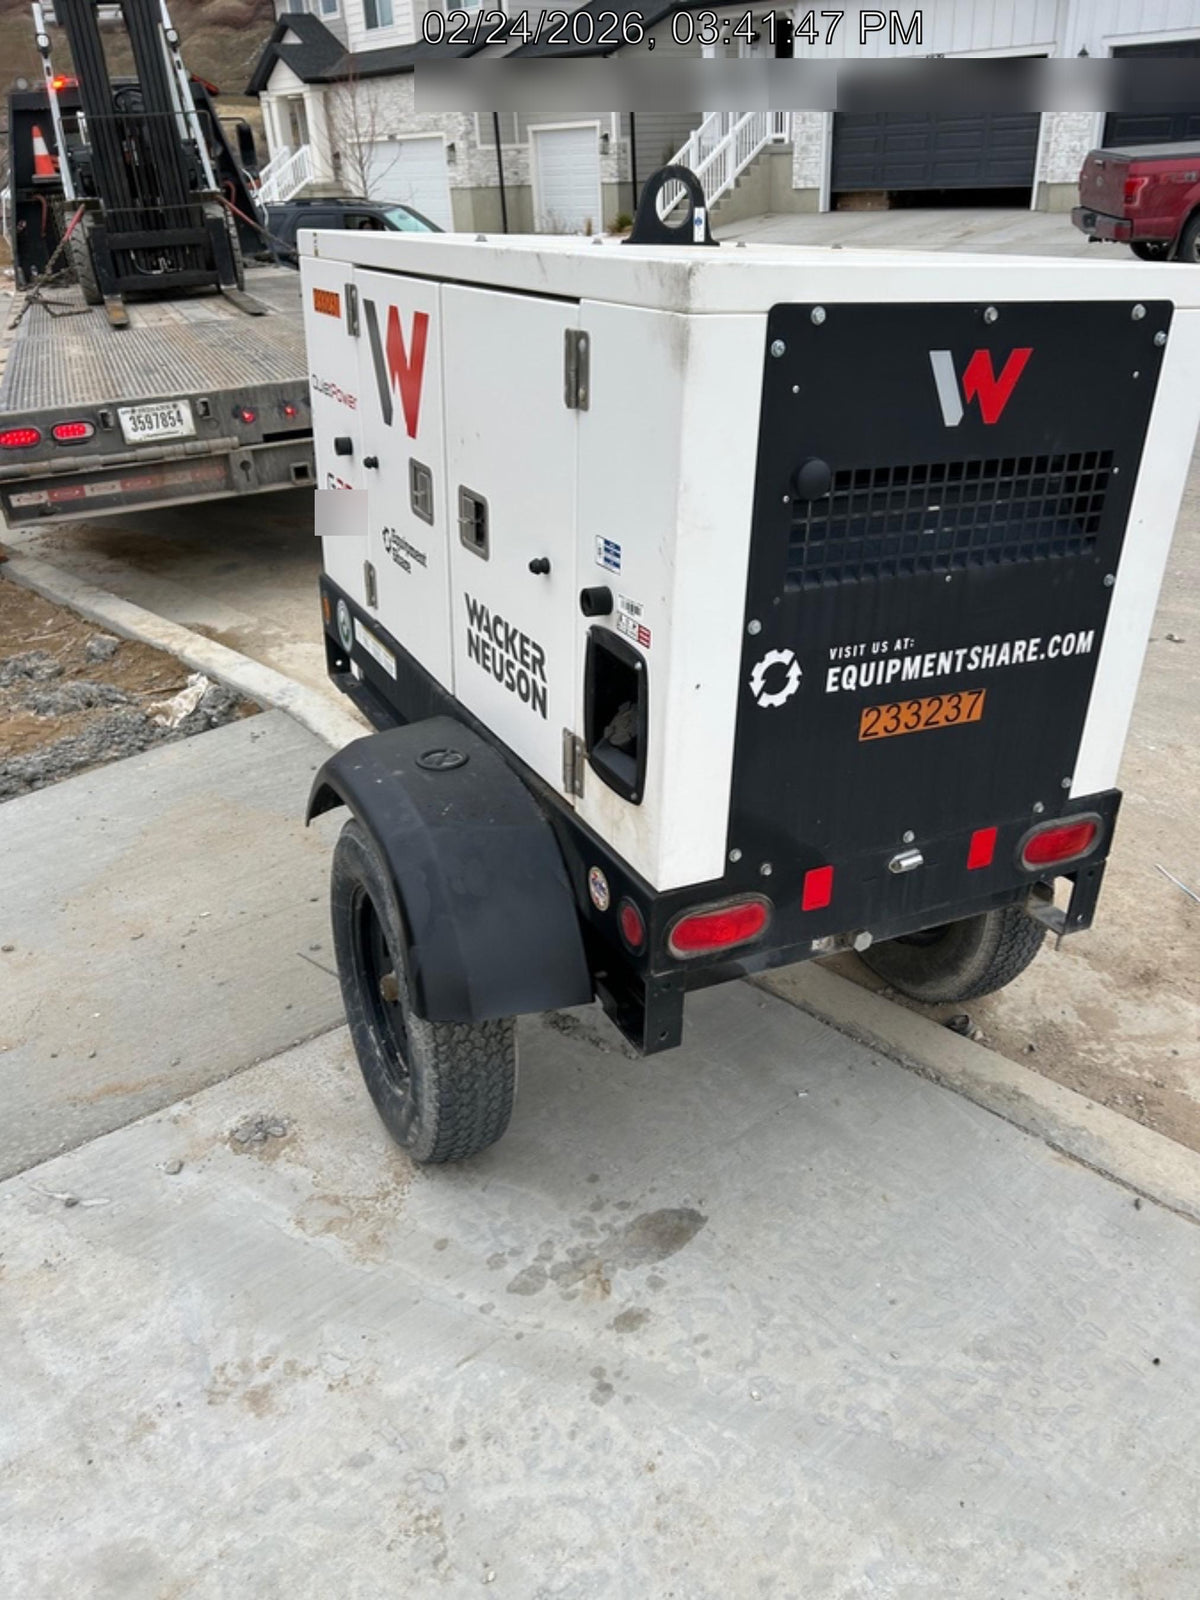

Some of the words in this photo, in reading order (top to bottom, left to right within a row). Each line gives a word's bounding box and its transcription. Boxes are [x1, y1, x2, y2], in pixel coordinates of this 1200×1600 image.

[129, 409, 184, 433] 3597854
[464, 592, 548, 684] WACKER
[825, 630, 1095, 693] EQUIPMENTSHARE.COM
[829, 643, 867, 661] VISIT
[872, 640, 889, 654] US
[894, 637, 916, 651] AT:
[467, 627, 548, 720] NEUSON
[861, 690, 984, 738] 233237
